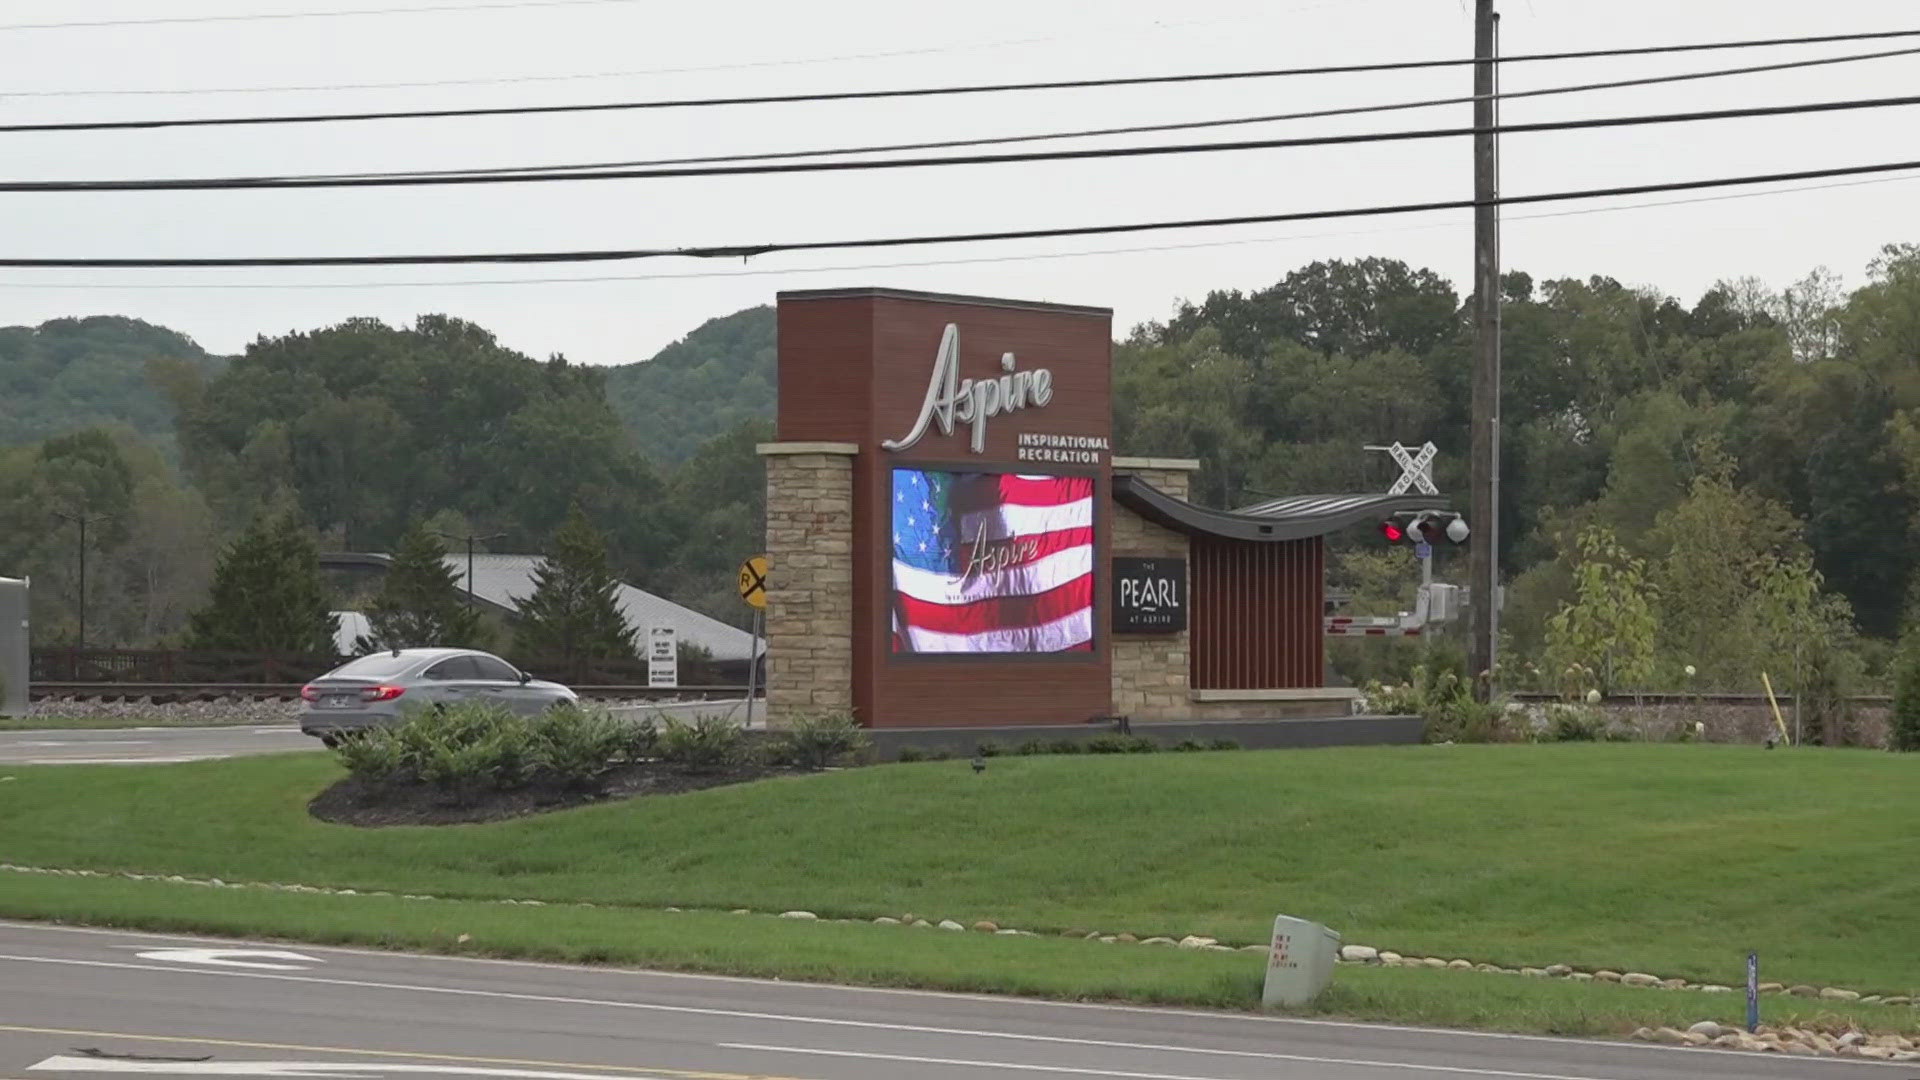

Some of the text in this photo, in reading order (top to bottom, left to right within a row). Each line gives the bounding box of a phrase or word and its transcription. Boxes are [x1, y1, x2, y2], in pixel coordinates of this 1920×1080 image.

[881, 323, 1053, 453] Aspire
[1018, 433, 1109, 450] INSPIRATIONAL
[1018, 447, 1099, 464] RECREATION
[1391, 445, 1409, 468] RAIL
[1392, 446, 1433, 495] CROSSING
[946, 518, 1039, 588] Aspire
[741, 573, 751, 587] R
[1121, 577, 1179, 608] PEARL
[1130, 615, 1171, 624] AT ASPIRE
